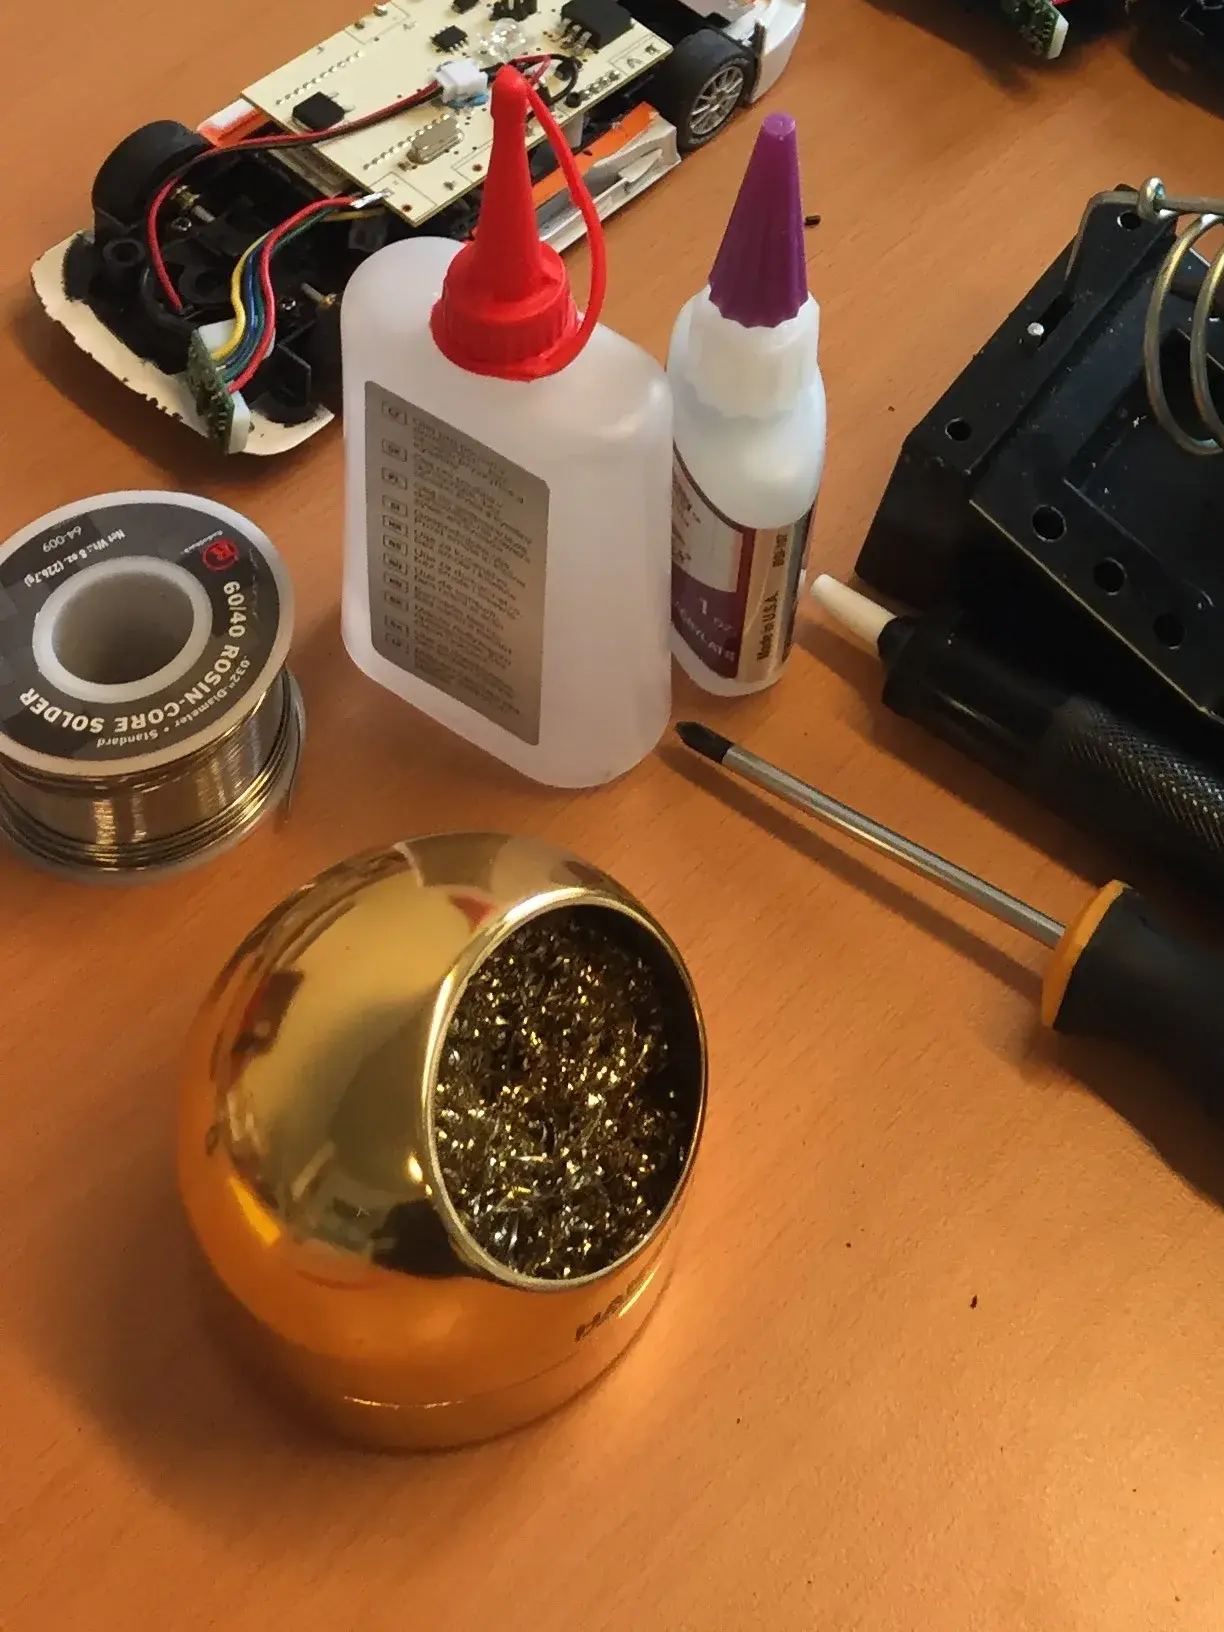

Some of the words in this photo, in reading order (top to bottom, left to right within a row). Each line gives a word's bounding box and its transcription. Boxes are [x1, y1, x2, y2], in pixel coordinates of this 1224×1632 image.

[42, 525, 82, 553] 64-009
[107, 528, 126, 543] Net
[78, 548, 88, 559] 8
[223, 580, 248, 638] 60/40
[756, 633, 775, 662] Made
[114, 643, 241, 734] ROSIN-CORE
[19, 687, 105, 734] SOLDER
[95, 728, 159, 749] Standard
